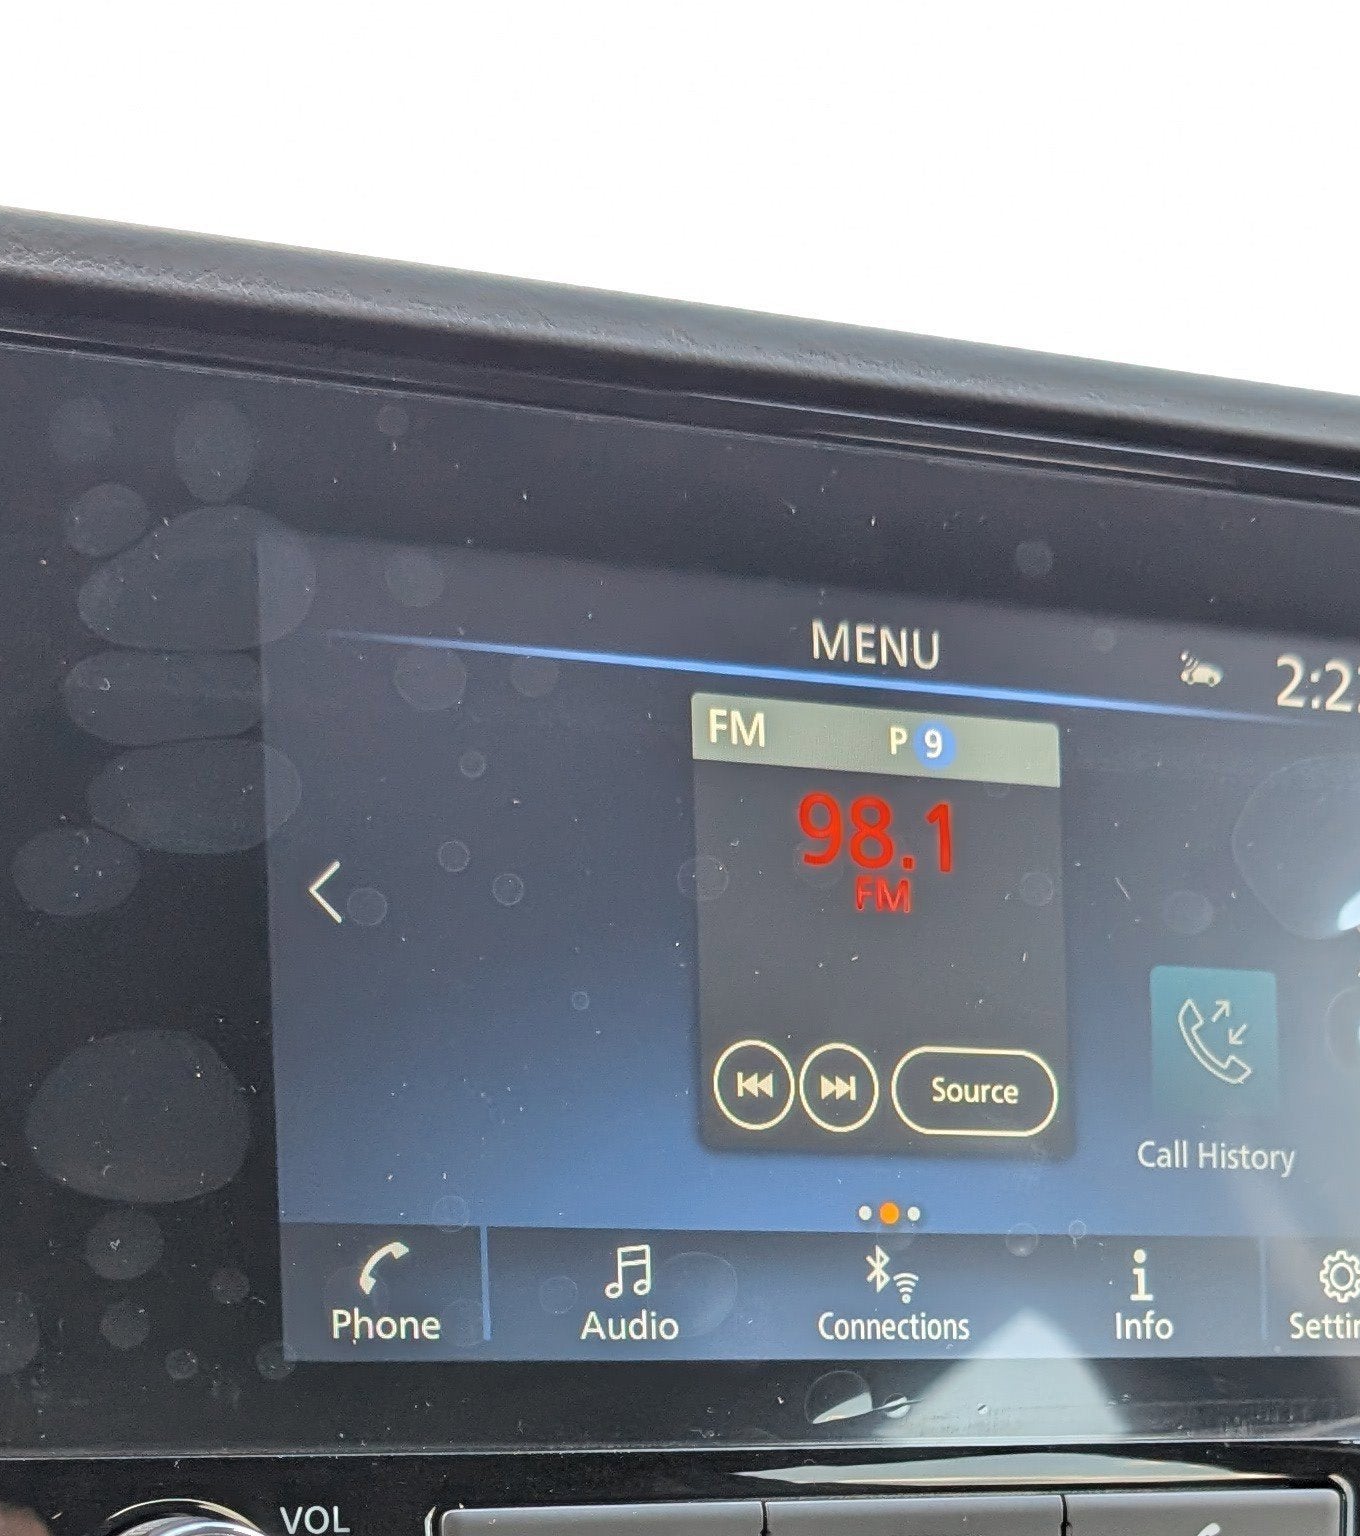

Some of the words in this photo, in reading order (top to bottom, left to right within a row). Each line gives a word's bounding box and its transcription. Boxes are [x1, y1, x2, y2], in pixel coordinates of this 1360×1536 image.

[811, 618, 941, 671] MENU
[707, 708, 767, 748] FM
[797, 792, 953, 873] 98.1
[854, 876, 912, 914] FM
[931, 1076, 1020, 1106] Source
[1137, 1141, 1189, 1169] Call
[1196, 1143, 1296, 1178] History
[331, 1309, 442, 1341] Phone
[580, 1310, 680, 1341] Audio
[817, 1312, 971, 1342] Connections
[1115, 1312, 1175, 1341] Info
[279, 1505, 352, 1536] VOL
